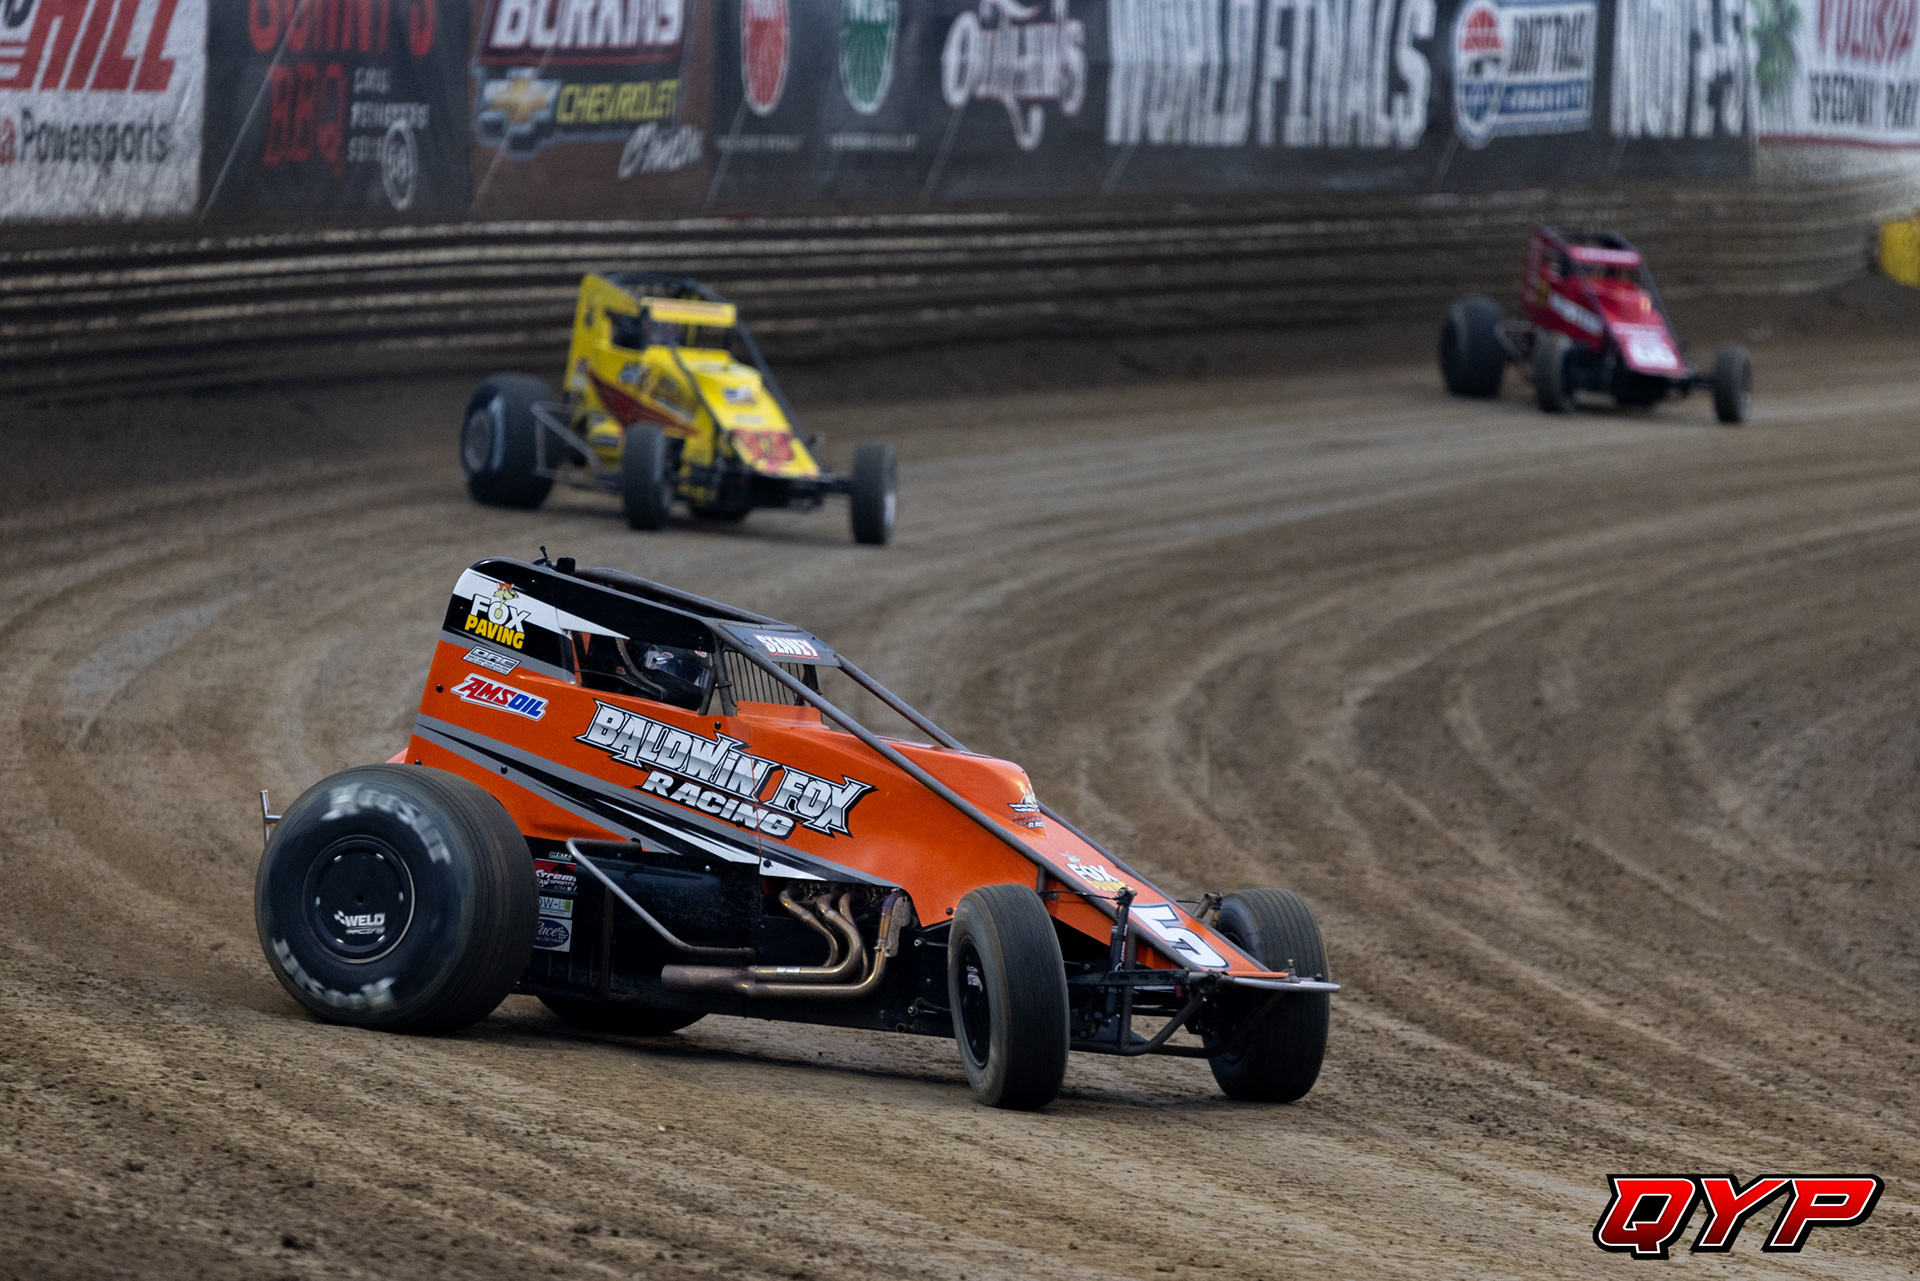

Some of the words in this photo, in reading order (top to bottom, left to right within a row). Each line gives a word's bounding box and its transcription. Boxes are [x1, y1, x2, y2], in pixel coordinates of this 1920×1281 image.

[556, 79, 682, 123] CHEVROLET
[20, 108, 170, 176] Powersports
[464, 614, 525, 649] PAVING
[470, 594, 531, 633] FOX
[754, 634, 819, 658] SEAVEY
[459, 677, 545, 718] AMSOIL
[769, 768, 874, 834] FOX
[344, 913, 386, 927] WELD
[1130, 902, 1232, 970] 5
